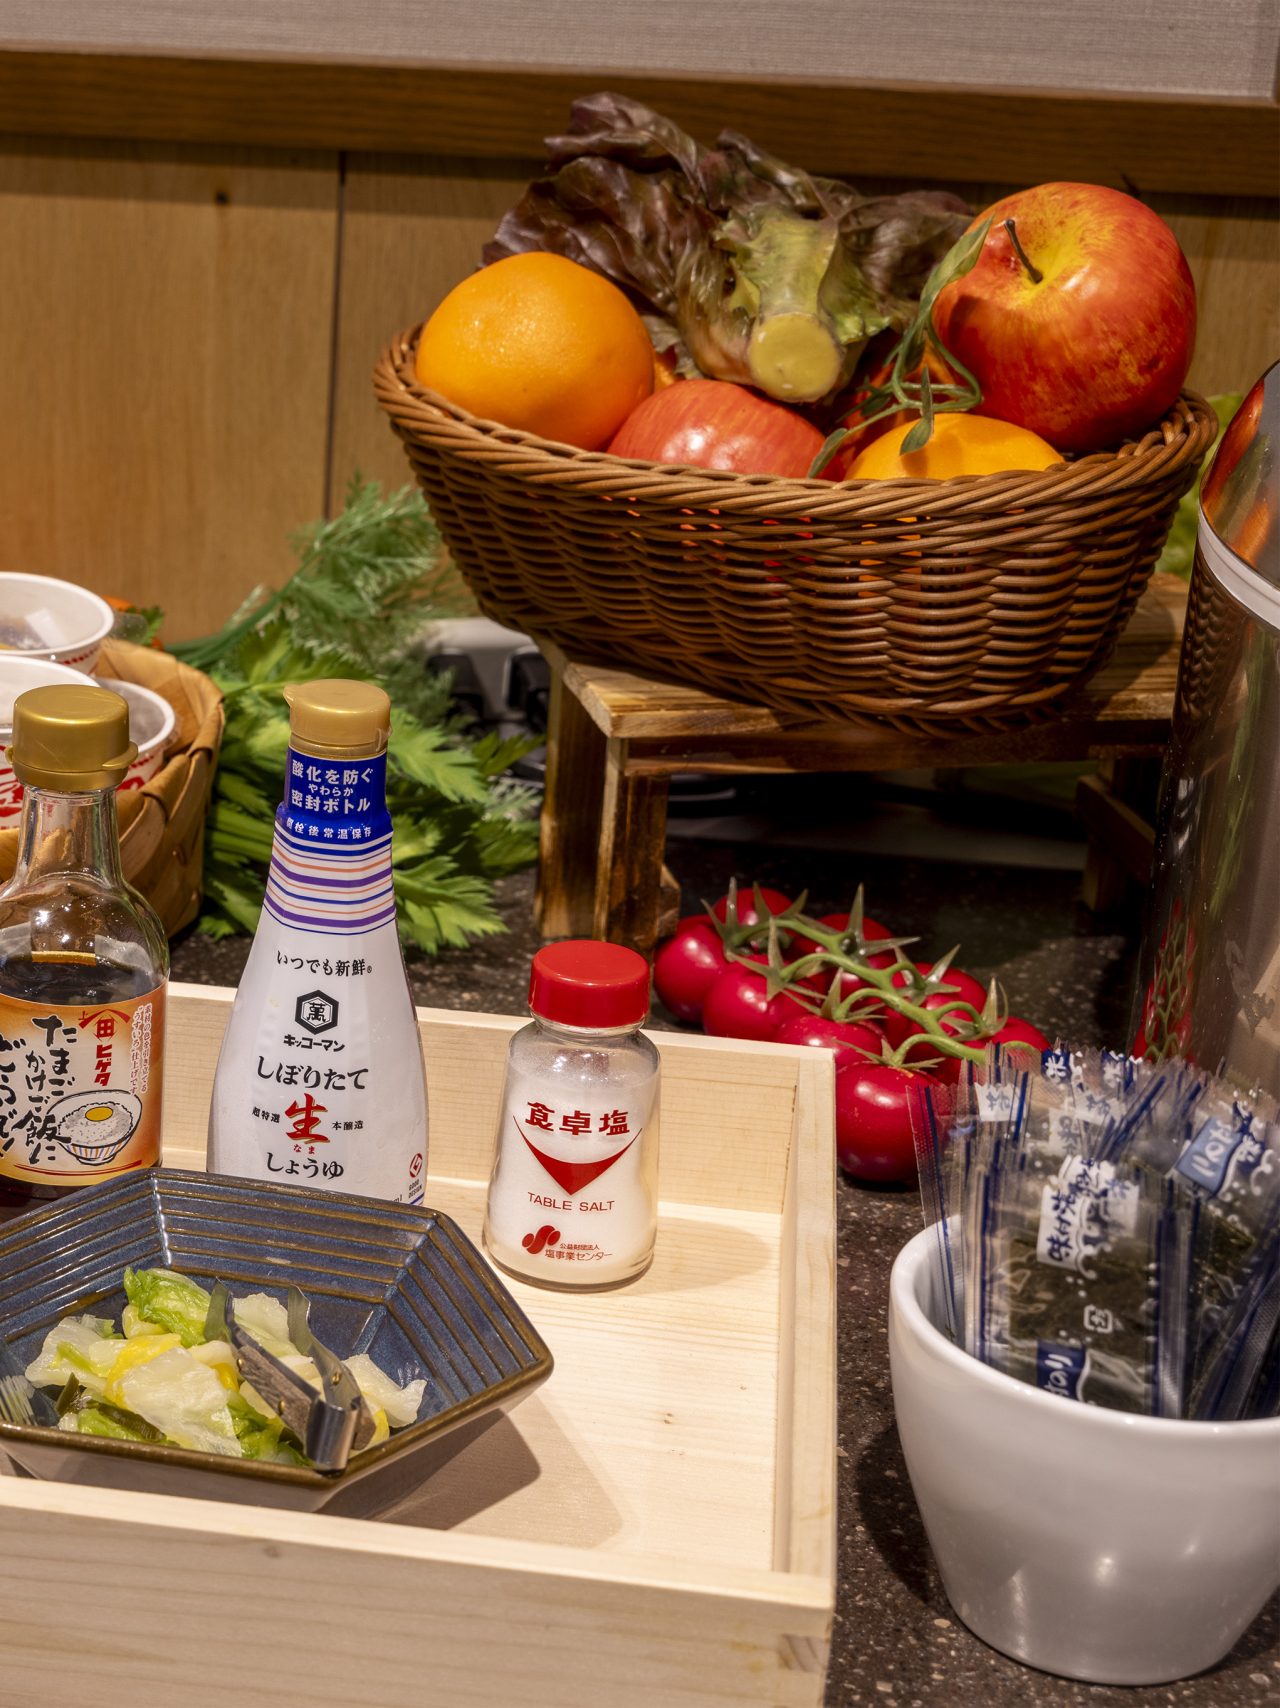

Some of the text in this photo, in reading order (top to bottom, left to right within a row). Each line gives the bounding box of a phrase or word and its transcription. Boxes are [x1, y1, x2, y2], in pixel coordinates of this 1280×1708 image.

[292, 760, 373, 785] 酸化を防ぐ
[291, 789, 371, 814] 密封ボトル
[308, 783, 354, 797] やわらか
[286, 817, 372, 839] 開栓後常温保存
[32, 1015, 78, 1096] たまご
[283, 1034, 345, 1052] キッコーマン
[95, 1044, 113, 1087] ヒゲタ
[257, 1055, 369, 1091] しぼりたて
[11, 1050, 72, 1165] かけご飯に
[252, 1106, 280, 1124] 超特選
[284, 1093, 330, 1144] 生
[524, 1101, 630, 1136] 食卓塩
[332, 1120, 364, 1131] 本醸造
[294, 1144, 316, 1155] なま
[267, 1152, 344, 1180] しょうゆ
[527, 1192, 615, 1211] TABLE SALT
[545, 1249, 613, 1261] 塩事業センター
